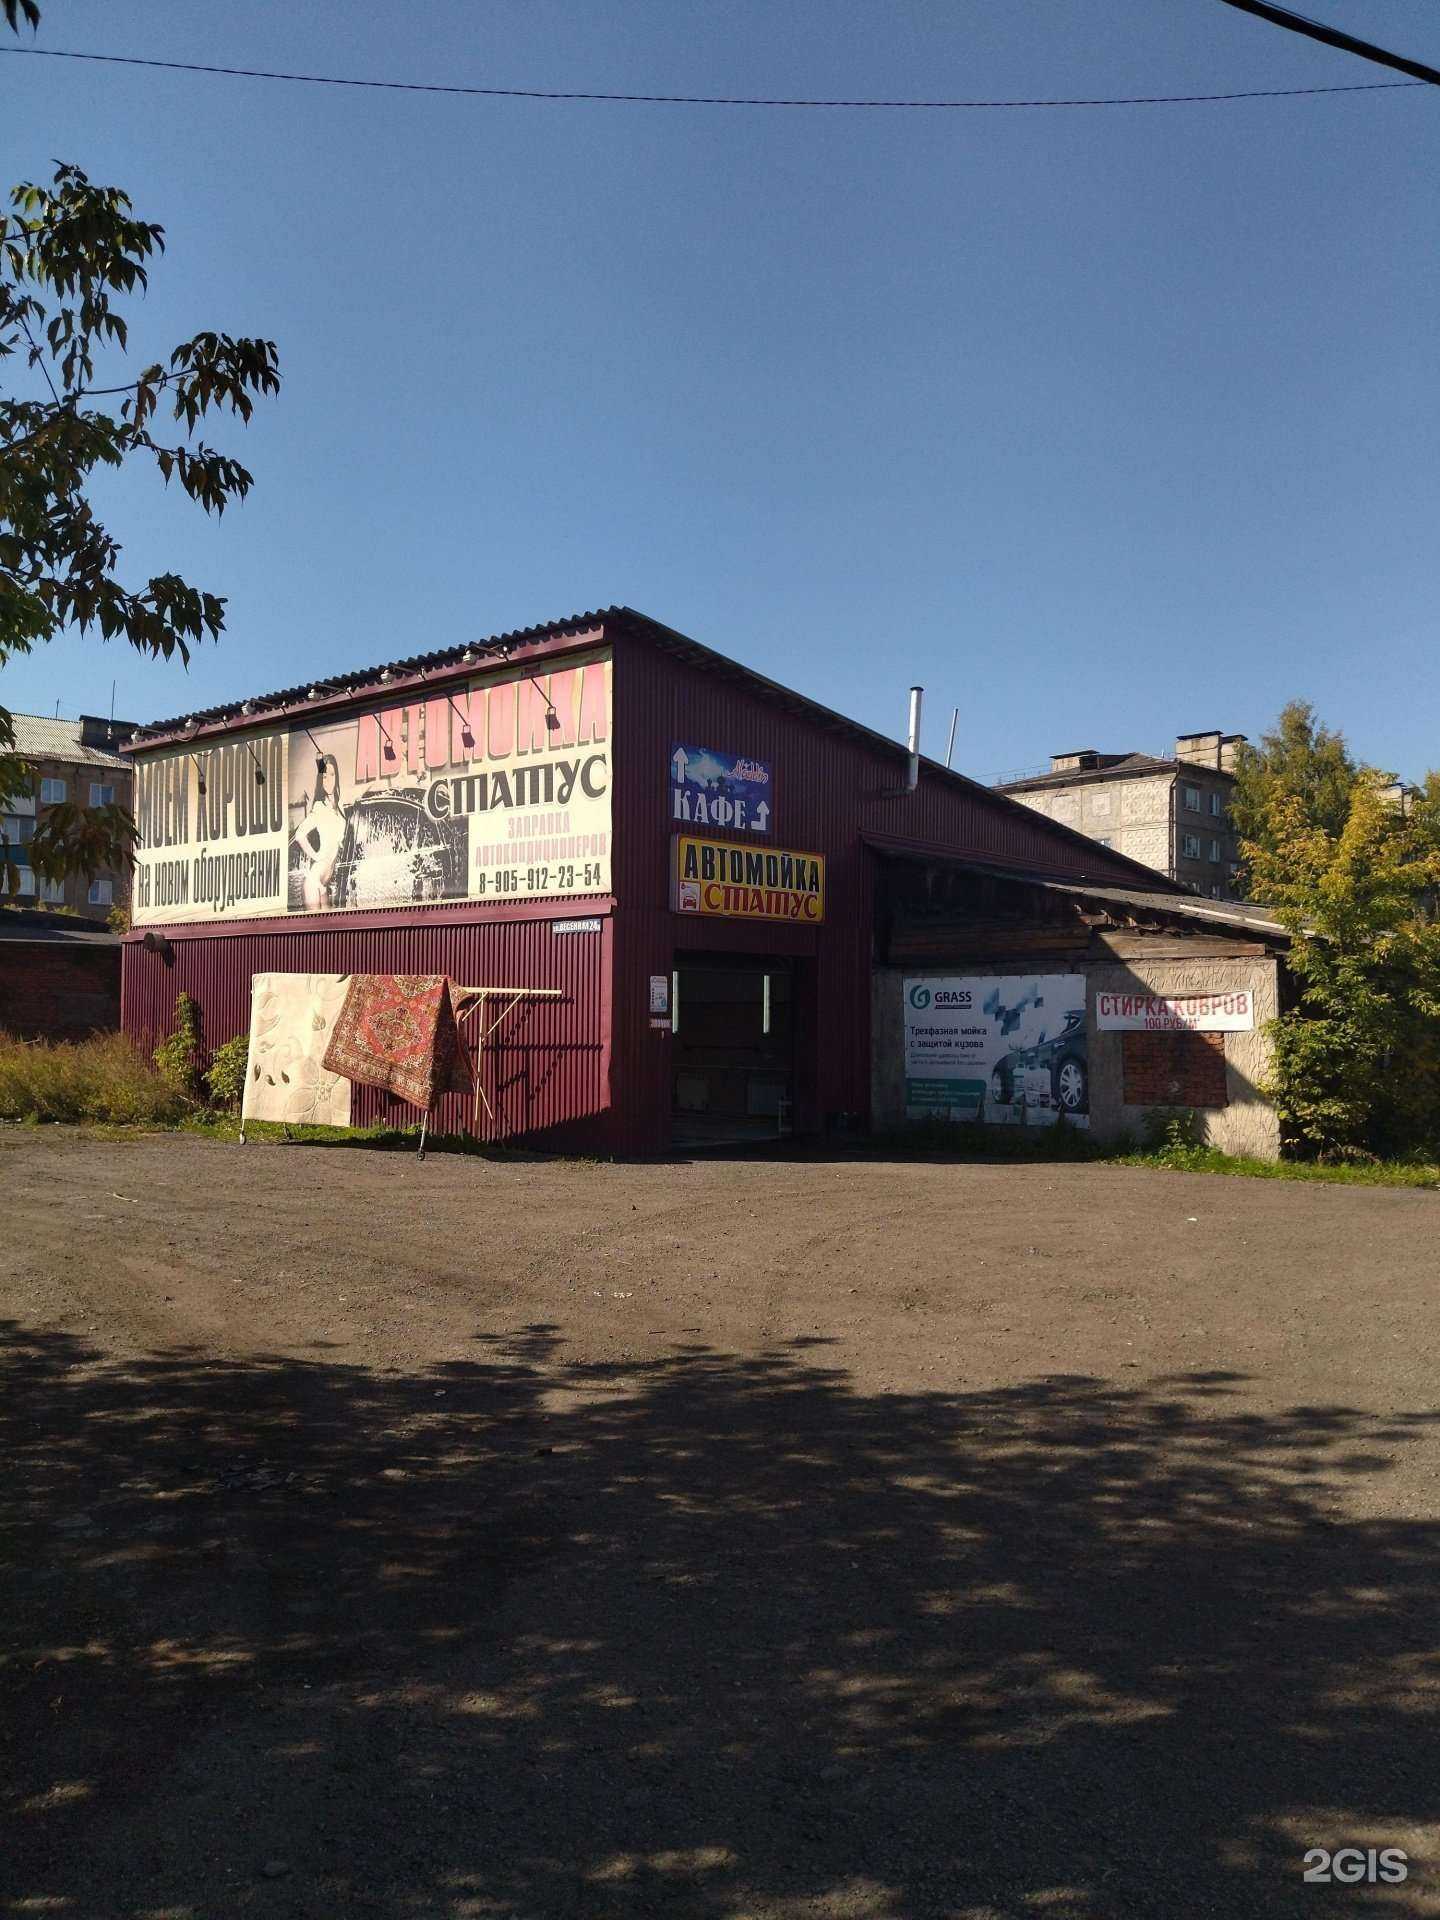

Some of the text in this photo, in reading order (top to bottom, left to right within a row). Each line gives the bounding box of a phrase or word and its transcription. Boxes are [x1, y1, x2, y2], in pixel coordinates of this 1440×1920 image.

[138, 735, 284, 850] МОЕМ ХОРОШО
[426, 753, 608, 820] СТАТУС
[508, 811, 571, 840] ЗАПРАВКА
[673, 788, 746, 830] КАФЕ
[475, 832, 607, 867] АВТОКОНДИЦИОНЕРОВ
[138, 847, 281, 912] на новом оборудовании
[479, 863, 601, 894] 8-905-912-23-54
[684, 843, 820, 892] АВТОМОЙКА
[704, 883, 818, 919] СТАТУС
[934, 991, 972, 1003] GRASS
[1100, 993, 1248, 1016] СТИРКА КОВРОВ
[910, 1026, 987, 1038] Трехфазная мойка
[1144, 1017, 1161, 1030] 100
[918, 1039, 952, 1049] защитой
[954, 1041, 984, 1050] кузова
